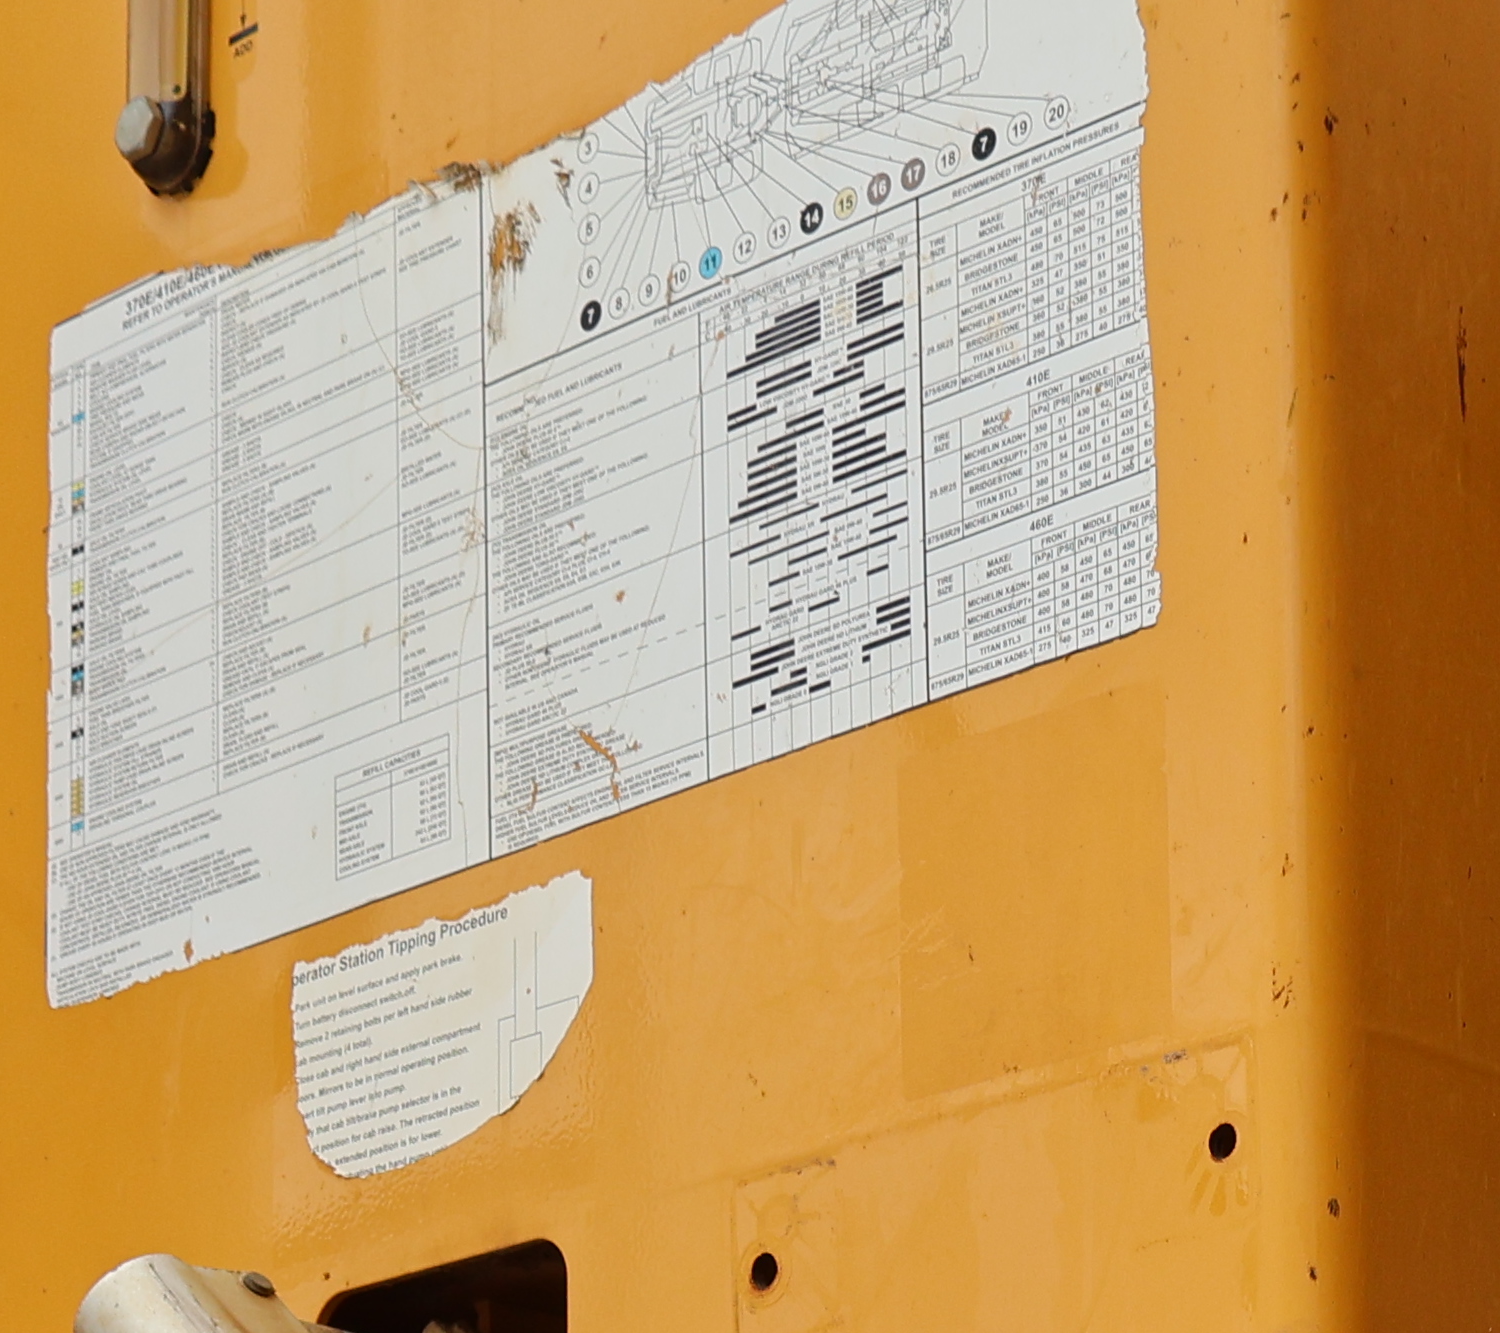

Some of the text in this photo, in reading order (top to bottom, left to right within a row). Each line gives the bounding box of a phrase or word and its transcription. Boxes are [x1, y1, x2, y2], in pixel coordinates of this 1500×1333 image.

[1049, 105, 1065, 121] 20
[1012, 122, 1028, 138] 19
[585, 142, 592, 154] 3
[980, 135, 988, 150] 7
[941, 152, 956, 169] 18
[952, 123, 1120, 199] RECOMMENDED TIRE INFLATION PRESSURES
[905, 167, 921, 183] 17
[585, 182, 593, 194] 4
[871, 181, 887, 196] 16
[838, 196, 854, 212] 15
[805, 211, 819, 227] 14
[585, 222, 593, 235] 5
[772, 225, 787, 241] 13
[738, 241, 752, 256] 12
[704, 255, 717, 270] 11
[586, 265, 594, 279] 6
[673, 269, 687, 284] 10
[645, 284, 653, 298] 9
[616, 297, 623, 310] 8
[653, 313, 671, 328] FUEL
[672, 305, 687, 319] AND
[1026, 370, 1050, 388] 410E
[1029, 515, 1054, 532] 460E
[1041, 501, 1150, 547] FRONT MIDDLE REAR
[986, 564, 1013, 579] MODEL
[936, 575, 954, 587] TIRE
[968, 589, 1004, 608] MICHELIN
[1036, 570, 1050, 582] 400
[937, 585, 954, 597] SIZE
[1037, 588, 1050, 600] 400
[973, 605, 1051, 642] BRIDGESTONE 400
[980, 624, 1051, 656] TITAN STL3 415
[968, 658, 1004, 676] MICHELIN
[1038, 641, 1052, 653] 275
[339, 948, 384, 972] Station
[387, 931, 436, 956] Tipping
[440, 908, 507, 939] Procedure
[296, 999, 310, 1012] Park
[339, 985, 355, 998] level
[357, 978, 383, 993] surface
[385, 971, 398, 984] and
[400, 966, 420, 980] apply
[421, 959, 437, 975] park
[331, 1021, 362, 1037] retaining
[364, 1014, 382, 1027] bolts
[383, 1011, 395, 1023] per
[397, 1005, 409, 1017] left
[410, 999, 428, 1012] hand
[431, 994, 446, 1006] side
[447, 987, 472, 1001] rubber
[339, 997, 377, 1017] disconnect
[309, 1047, 342, 1063] mounting
[316, 1067, 329, 1079] cab
[330, 1062, 344, 1075] and
[346, 1057, 362, 1070] right
[364, 1051, 382, 1064] hand
[384, 1047, 399, 1058] side
[401, 1036, 430, 1053] external
[432, 1021, 481, 1044] compartment
[318, 1083, 343, 1097] Mirrors
[401, 1056, 435, 1073] operating
[327, 1100, 348, 1114] pump
[349, 1094, 367, 1105] lever
[331, 1118, 345, 1130] cab
[378, 1103, 400, 1118] pump
[401, 1094, 430, 1109] selector
[449, 1084, 461, 1095] the
[320, 1136, 350, 1153] position
[351, 1132, 361, 1142] for
[363, 1126, 376, 1138] cab
[399, 1117, 413, 1128] The
[414, 1106, 448, 1124] retracted
[449, 1099, 480, 1116] position
[335, 1148, 367, 1165] extended
[369, 1141, 398, 1158] position
